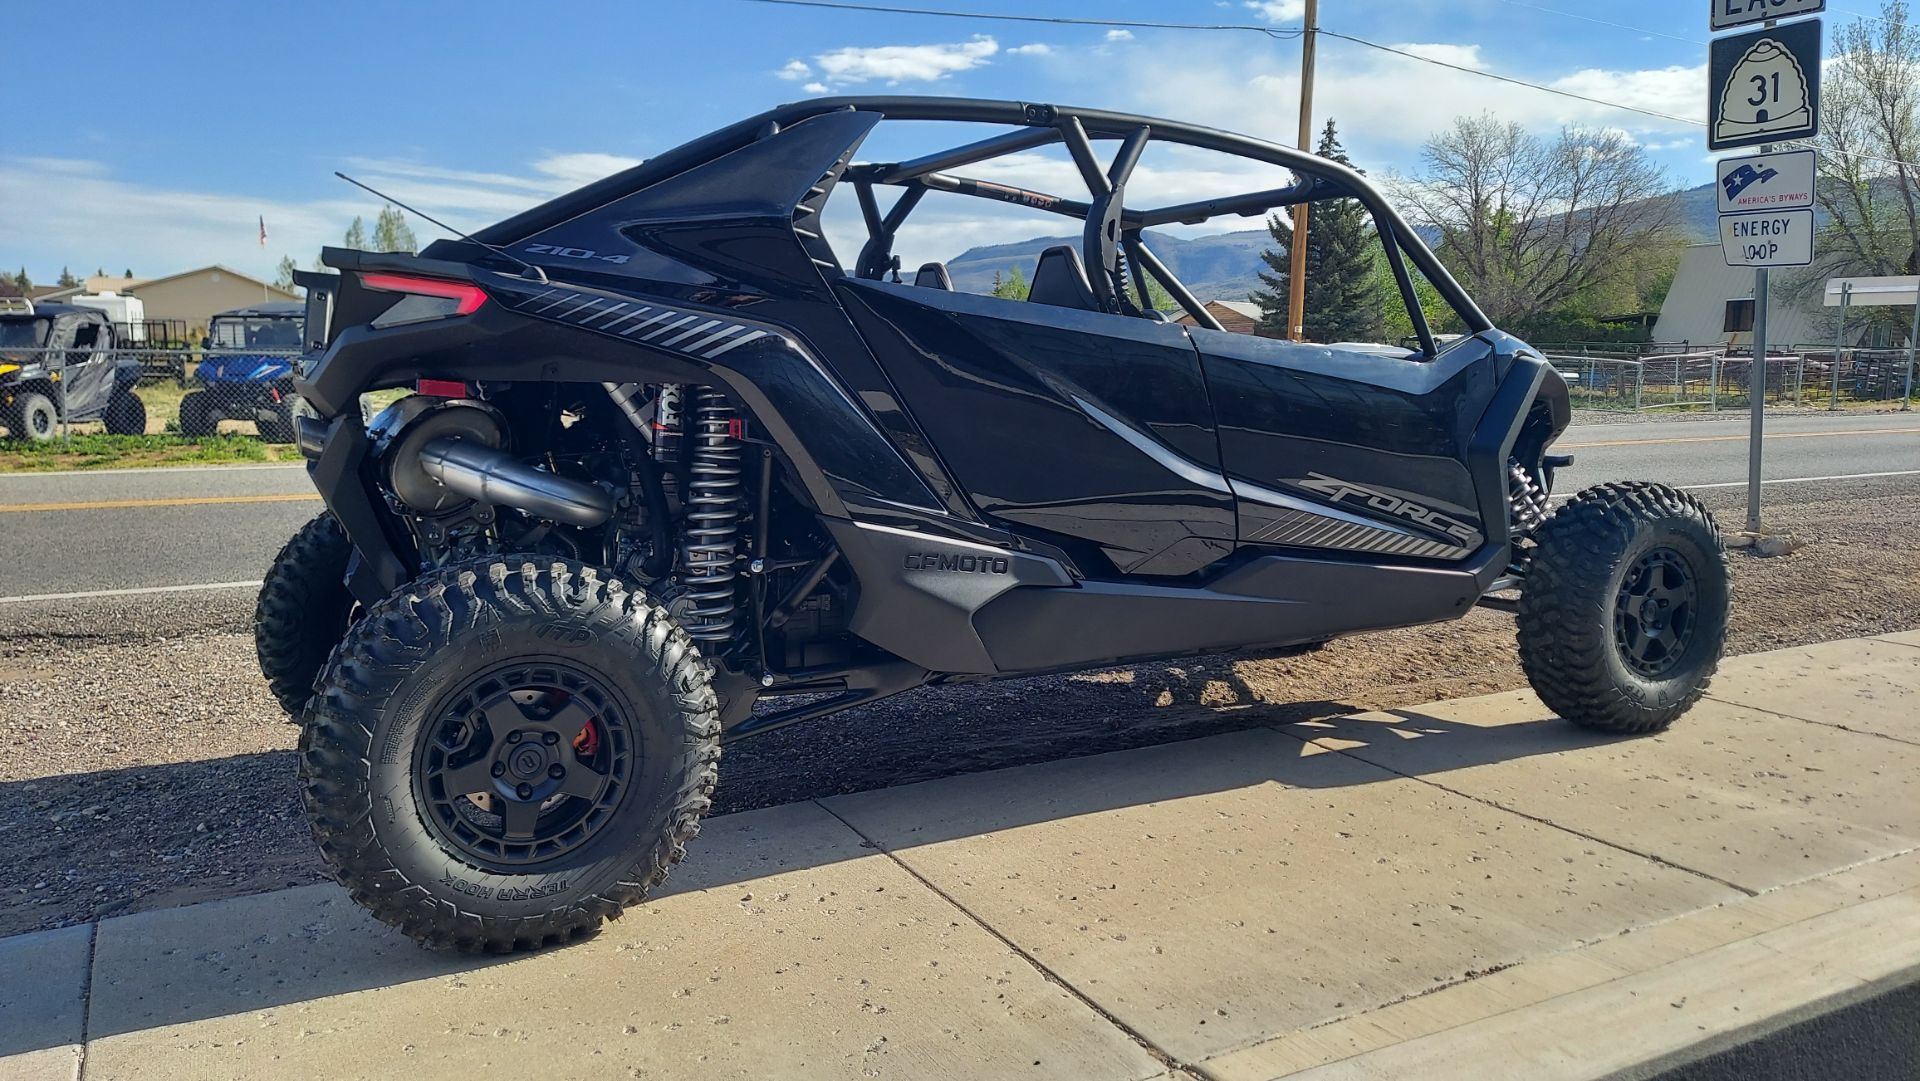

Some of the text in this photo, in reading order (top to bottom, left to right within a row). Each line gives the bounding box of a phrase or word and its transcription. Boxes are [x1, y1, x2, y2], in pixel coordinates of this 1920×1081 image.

[1747, 71, 1779, 106] 31
[1738, 192, 1808, 206] AMERICA'S BYWAYS
[1733, 218, 1790, 237] ENERGY
[524, 243, 631, 265] Z10-4
[1742, 243, 1778, 260] LOOP
[661, 383, 685, 426] FOX
[903, 552, 1009, 575] CFMOTO
[535, 624, 592, 644] ITP
[438, 867, 571, 901] TERRA HOOK
